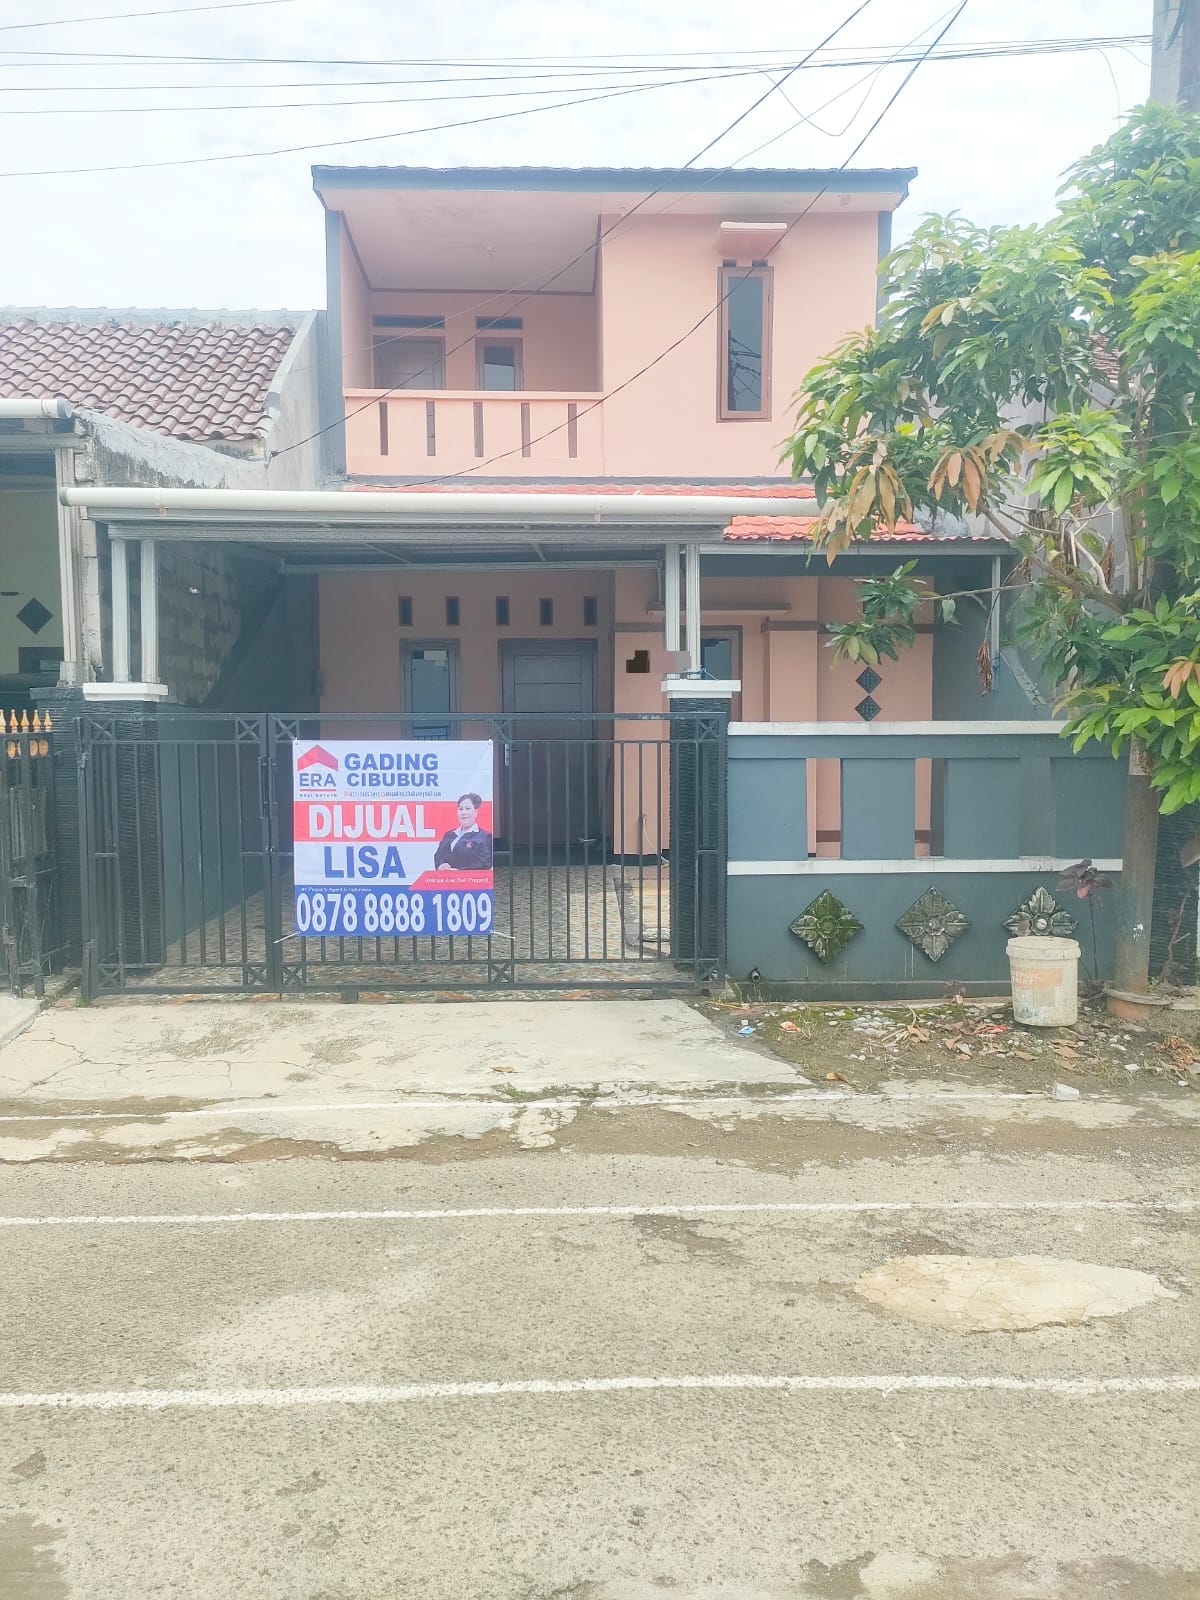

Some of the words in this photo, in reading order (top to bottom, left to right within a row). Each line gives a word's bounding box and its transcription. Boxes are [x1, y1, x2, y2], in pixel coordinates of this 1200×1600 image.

[345, 753, 438, 771] GADING
[299, 773, 336, 787] ERA
[346, 772, 439, 787] CIBUBUR
[309, 804, 435, 838] DIJUAL
[324, 845, 406, 879] LISA
[296, 892, 358, 932] 0878
[364, 892, 425, 932] 8888
[432, 892, 492, 932] 1809
